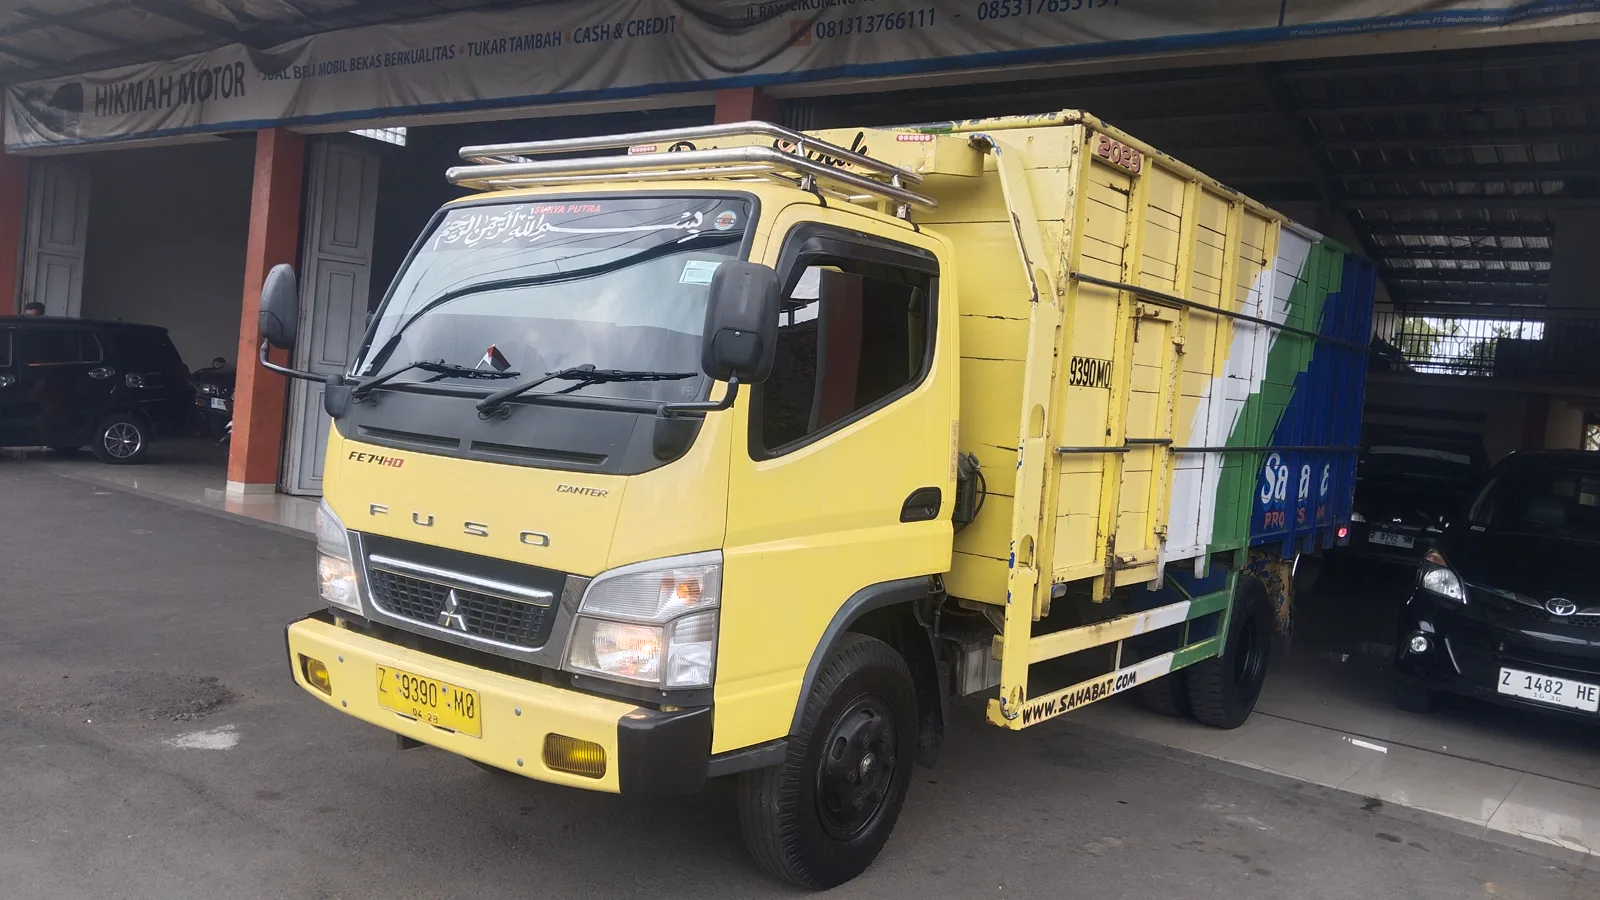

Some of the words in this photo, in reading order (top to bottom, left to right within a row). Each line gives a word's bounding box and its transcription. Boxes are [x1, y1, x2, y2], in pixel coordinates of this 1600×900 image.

[815, 7, 936, 40] 081313766111
[293, 63, 316, 79] BELI
[318, 58, 348, 77] MOBIL
[350, 53, 382, 72] BEKAS
[384, 44, 456, 68] BERKUALITAS
[467, 38, 507, 58] TUKAR
[509, 29, 563, 53] TAMBAH
[573, 22, 610, 45] CASH
[613, 20, 624, 40] &
[626, 14, 677, 38] CREDIT
[95, 75, 173, 117] HIKMAH
[178, 61, 246, 105] MOTOR
[1097, 135, 1141, 174] 2023
[566, 203, 602, 214] PUTRA
[348, 451, 405, 468] FE74HD
[555, 484, 610, 499] CANTER
[369, 503, 551, 548] FUSO
[378, 667, 387, 694] Z
[401, 673, 438, 708] 9390
[1022, 670, 1137, 725] WWW.SAHABAT.COM
[1501, 670, 1512, 686] Z
[1523, 675, 1564, 696] 1482
[1576, 684, 1597, 703] HE
